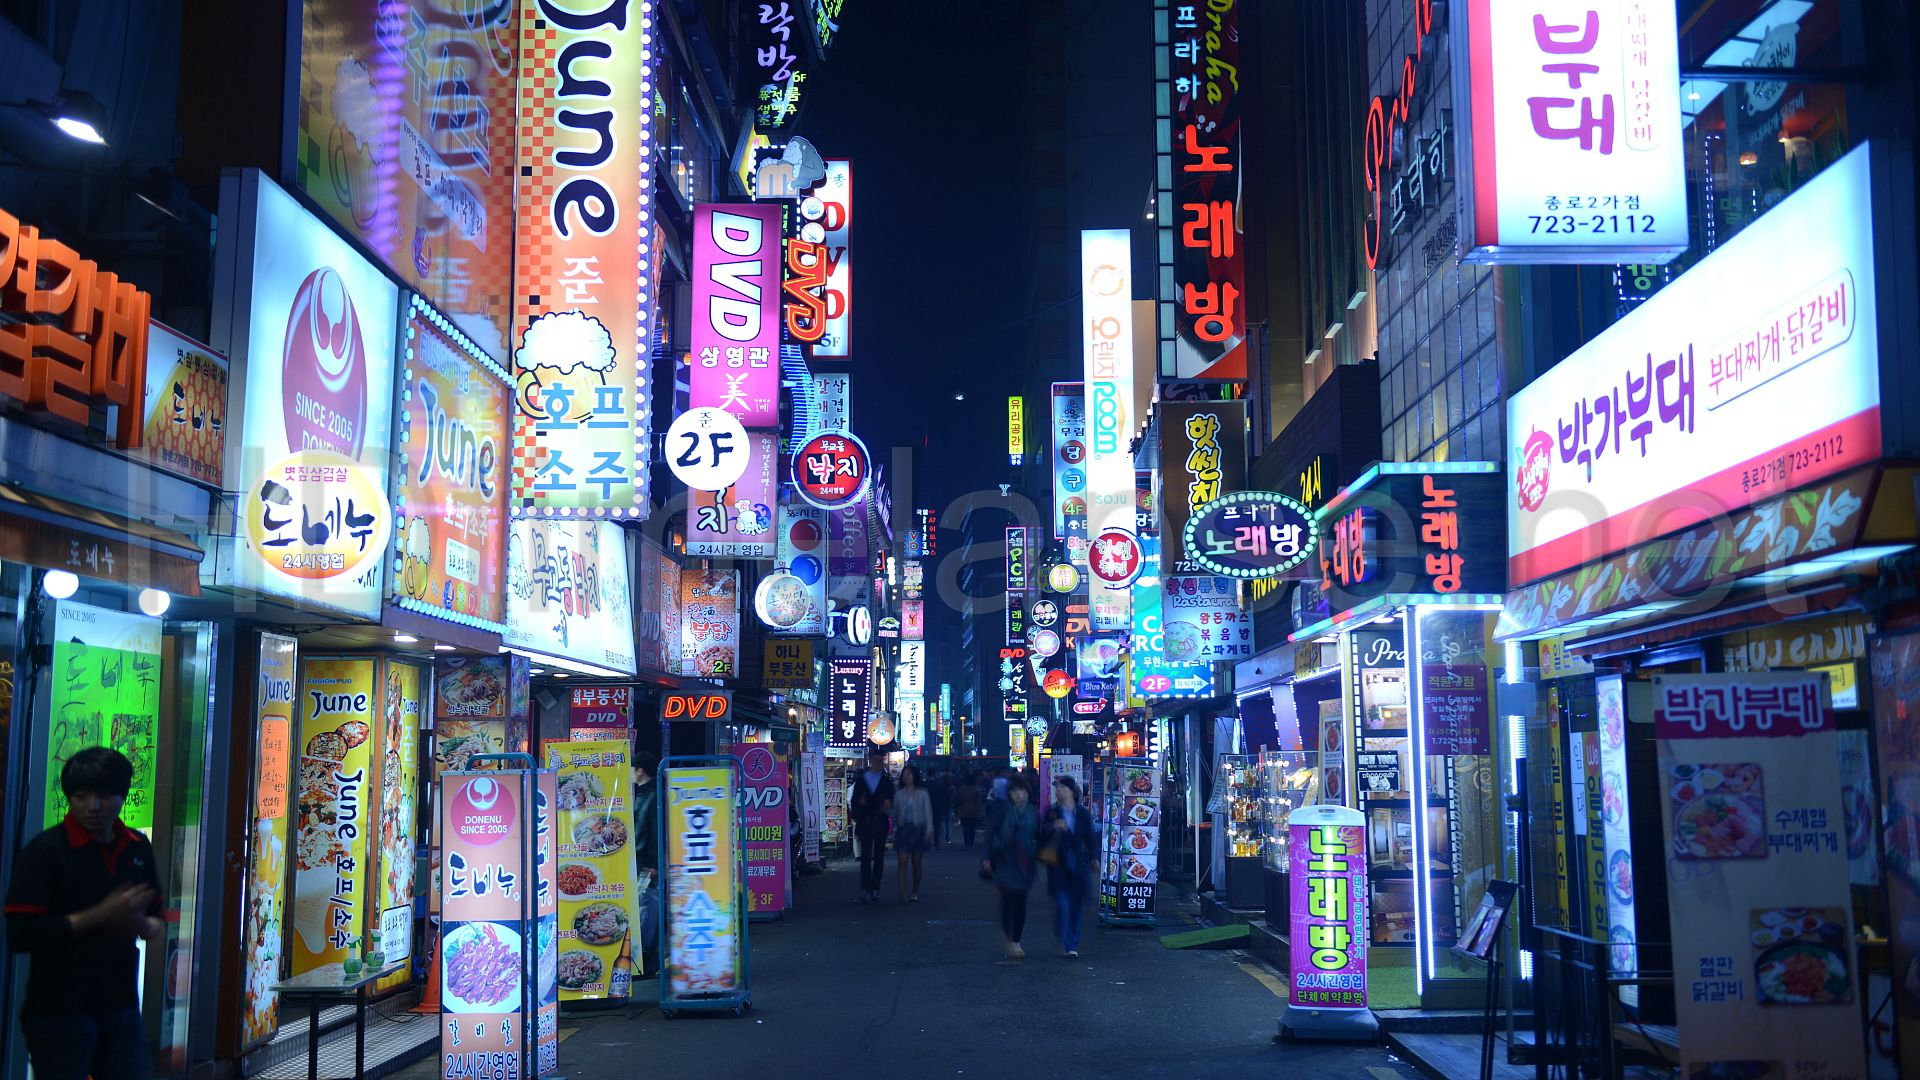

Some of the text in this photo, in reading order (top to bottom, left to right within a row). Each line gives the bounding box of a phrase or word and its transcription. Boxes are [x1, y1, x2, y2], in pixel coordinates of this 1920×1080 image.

[1174, 6, 1199, 100] 프라하
[792, 71, 806, 82] 6F
[1545, 195, 1640, 211] 종로2가점
[1183, 124, 1239, 342] 노래방
[1528, 215, 1656, 233] 723-2112
[557, 257, 605, 304] 준
[709, 209, 764, 343] DVD
[783, 238, 828, 342] DVD
[699, 346, 771, 369] 상영관
[719, 371, 752, 413] 美
[294, 389, 354, 443] SINCE 2005
[536, 383, 633, 431] 호프
[1558, 342, 1696, 484] 박가부대
[418, 376, 497, 503] June
[675, 430, 735, 469] 2F
[1789, 435, 1844, 474] 723-2112
[533, 450, 631, 501] 소주
[806, 453, 859, 484] 낙지
[1064, 502, 1084, 516] 4F
[1095, 495, 1127, 505] SOJU
[1223, 503, 1278, 522] 프라하
[842, 504, 863, 558] offee
[1204, 523, 1304, 557] 노래방
[1420, 474, 1465, 593] 노래방
[699, 544, 764, 557] 24시간 영업
[1319, 505, 1366, 592] 노래방
[281, 552, 346, 571] 24시영업
[1175, 561, 1201, 572] 725
[61, 608, 80, 621] SINCE
[1199, 612, 1250, 625] 왕돈까스
[1200, 627, 1250, 641] 볶음밥
[775, 644, 801, 659] 하나
[1000, 648, 1025, 659] DVD
[1200, 644, 1251, 656] 스파게티
[713, 659, 733, 674] 2F
[769, 662, 806, 677] 부동산
[834, 665, 865, 676] Luxury
[262, 674, 291, 706] June
[1145, 677, 1167, 690] 2F
[310, 690, 367, 718] June
[582, 688, 627, 706] 부동산
[664, 695, 729, 719] DVD
[1666, 682, 1820, 731] 박가부대
[585, 712, 618, 724] DVD
[841, 678, 858, 739] 노래방
[334, 769, 363, 840] June
[460, 824, 509, 835] SINCE 2005
[464, 814, 503, 825] DONENU
[448, 852, 517, 898] 도네누
[760, 893, 774, 905] 3F
[1122, 886, 1153, 898] 24시간
[1307, 828, 1352, 972] 노래방
[1127, 899, 1147, 910] 영업
[1698, 956, 1735, 977] 철판
[1296, 973, 1363, 989] 24시간영업
[1296, 989, 1364, 1004] 단체예약환영
[1691, 981, 1744, 1003] 닭갈비
[446, 1052, 520, 1080] 24시간영업
